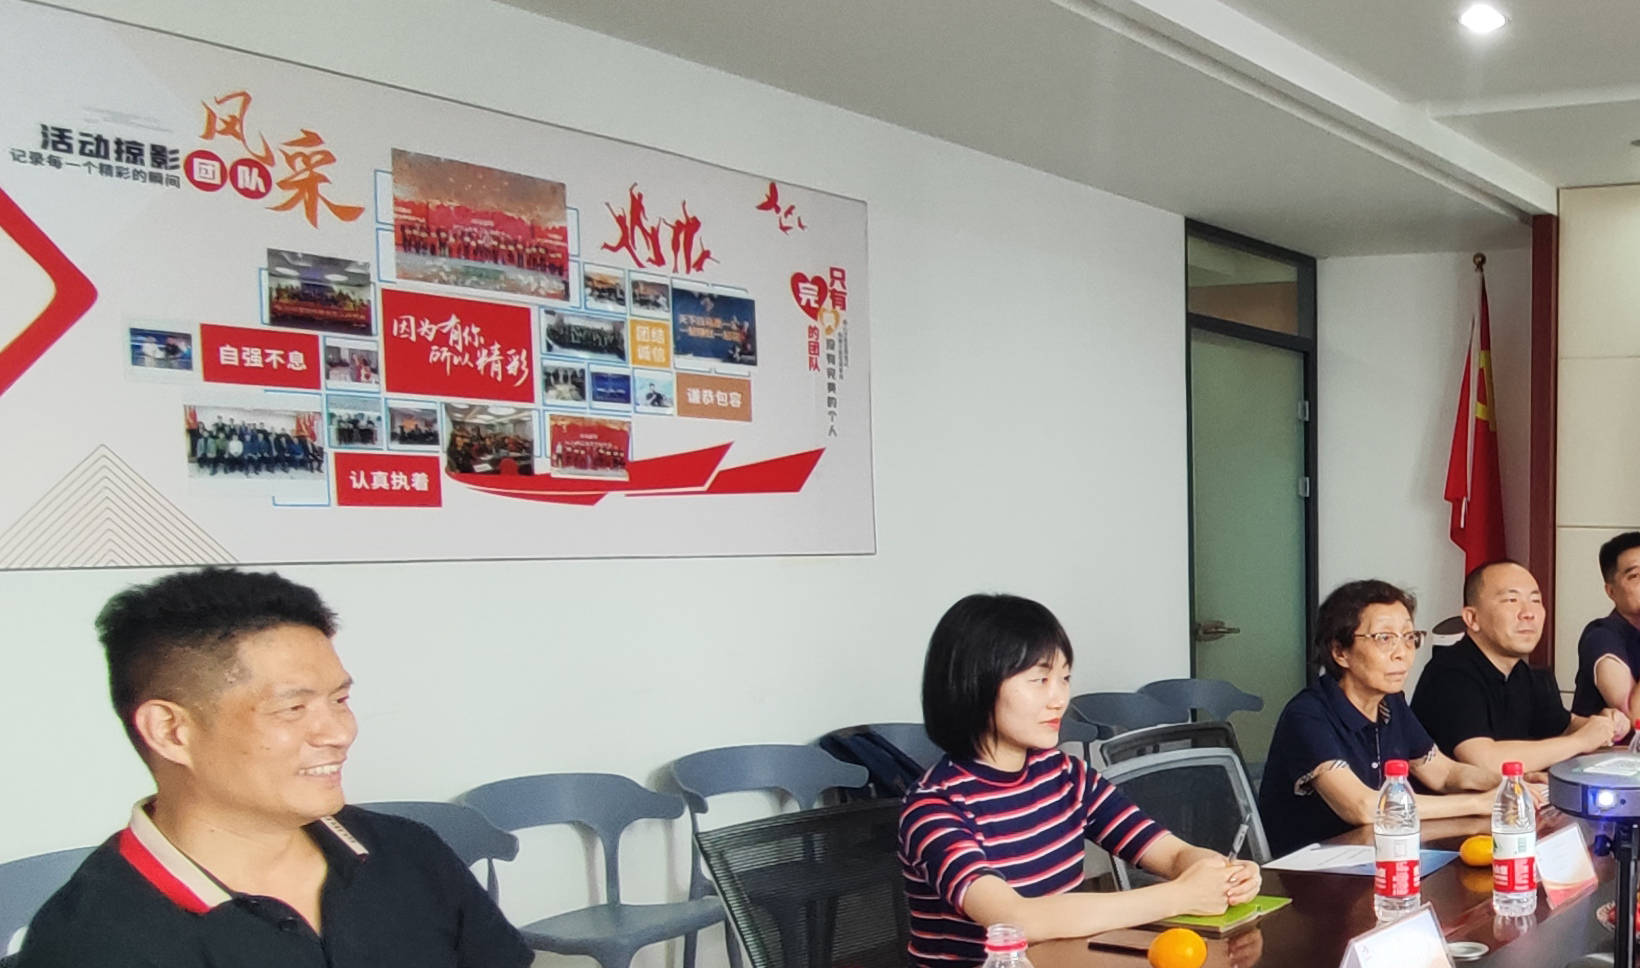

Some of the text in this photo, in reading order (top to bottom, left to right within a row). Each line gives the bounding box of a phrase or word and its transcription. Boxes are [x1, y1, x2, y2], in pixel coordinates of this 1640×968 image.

[40, 124, 181, 171] 活动掠影
[9, 148, 181, 189] 记录每一个精彩的瞬间
[192, 157, 267, 193] 团队
[829, 266, 848, 312] 只有
[392, 313, 485, 353] 因为有你
[807, 325, 821, 373] 的团队
[219, 344, 308, 371] 自强不息
[429, 340, 530, 388] 所以精彩
[349, 470, 430, 492] 认真执着
